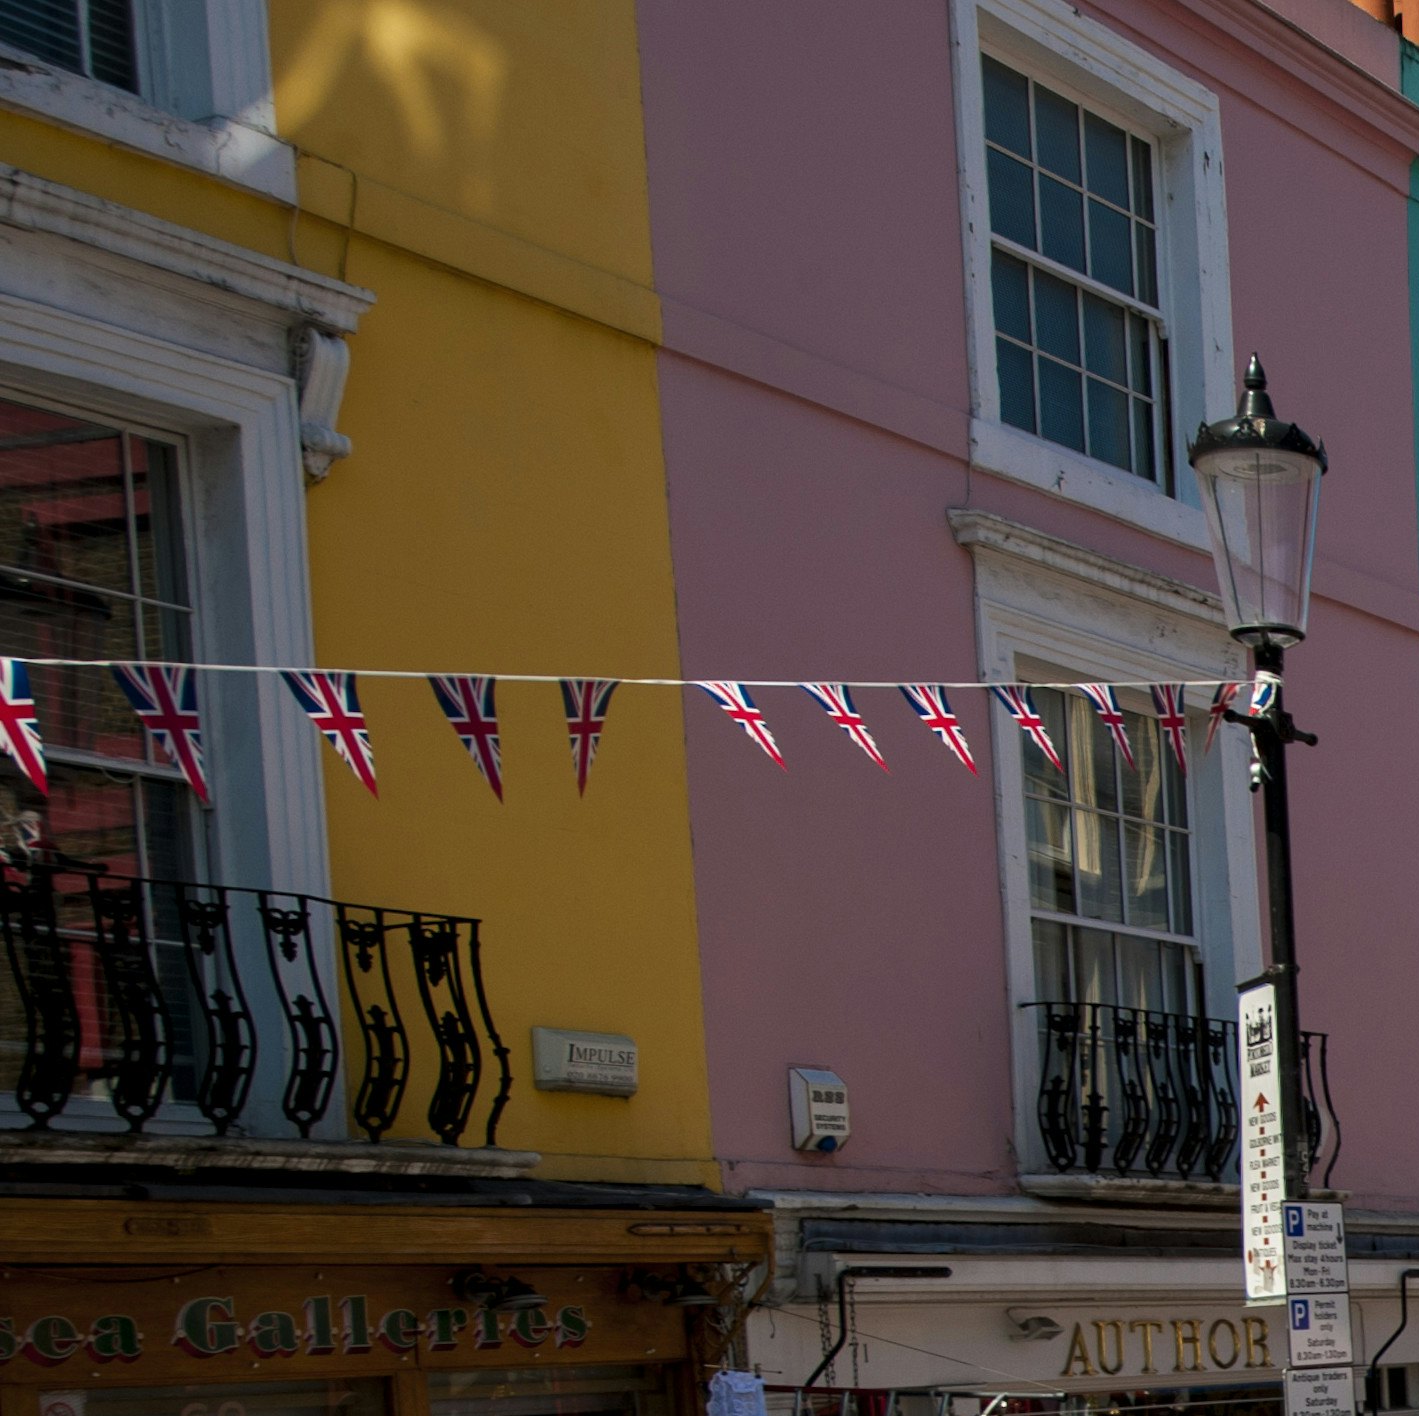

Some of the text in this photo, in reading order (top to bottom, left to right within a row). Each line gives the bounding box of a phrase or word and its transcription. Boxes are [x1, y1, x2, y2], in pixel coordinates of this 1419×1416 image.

[567, 1043, 635, 1066] IMPULSE
[1250, 1060, 1271, 1078] MARKET
[814, 1114, 846, 1123] SECURITY
[1260, 1112, 1277, 1124] GOODS
[816, 1123, 846, 1131] SYSTEMS
[1262, 1155, 1280, 1168] MARKET
[1262, 1179, 1279, 1191] GOODS
[1307, 1208, 1320, 1221] Pay
[1321, 1208, 1329, 1219] at
[1307, 1222, 1333, 1232] machine
[1292, 1240, 1338, 1252] Display ticket
[1287, 1253, 1302, 1263] Max
[1304, 1254, 1318, 1265] stay
[1315, 1301, 1336, 1309] Permit
[1314, 1311, 1338, 1320] holders
[170, 1295, 592, 1360] Galleries
[1320, 1324, 1334, 1333] only
[1059, 1315, 1276, 1377] AUTHOR
[1307, 1338, 1335, 1348] Saturday
[1292, 1371, 1348, 1384] Antique traders
[1312, 1385, 1329, 1395] only
[1305, 1397, 1338, 1408] Saturday
